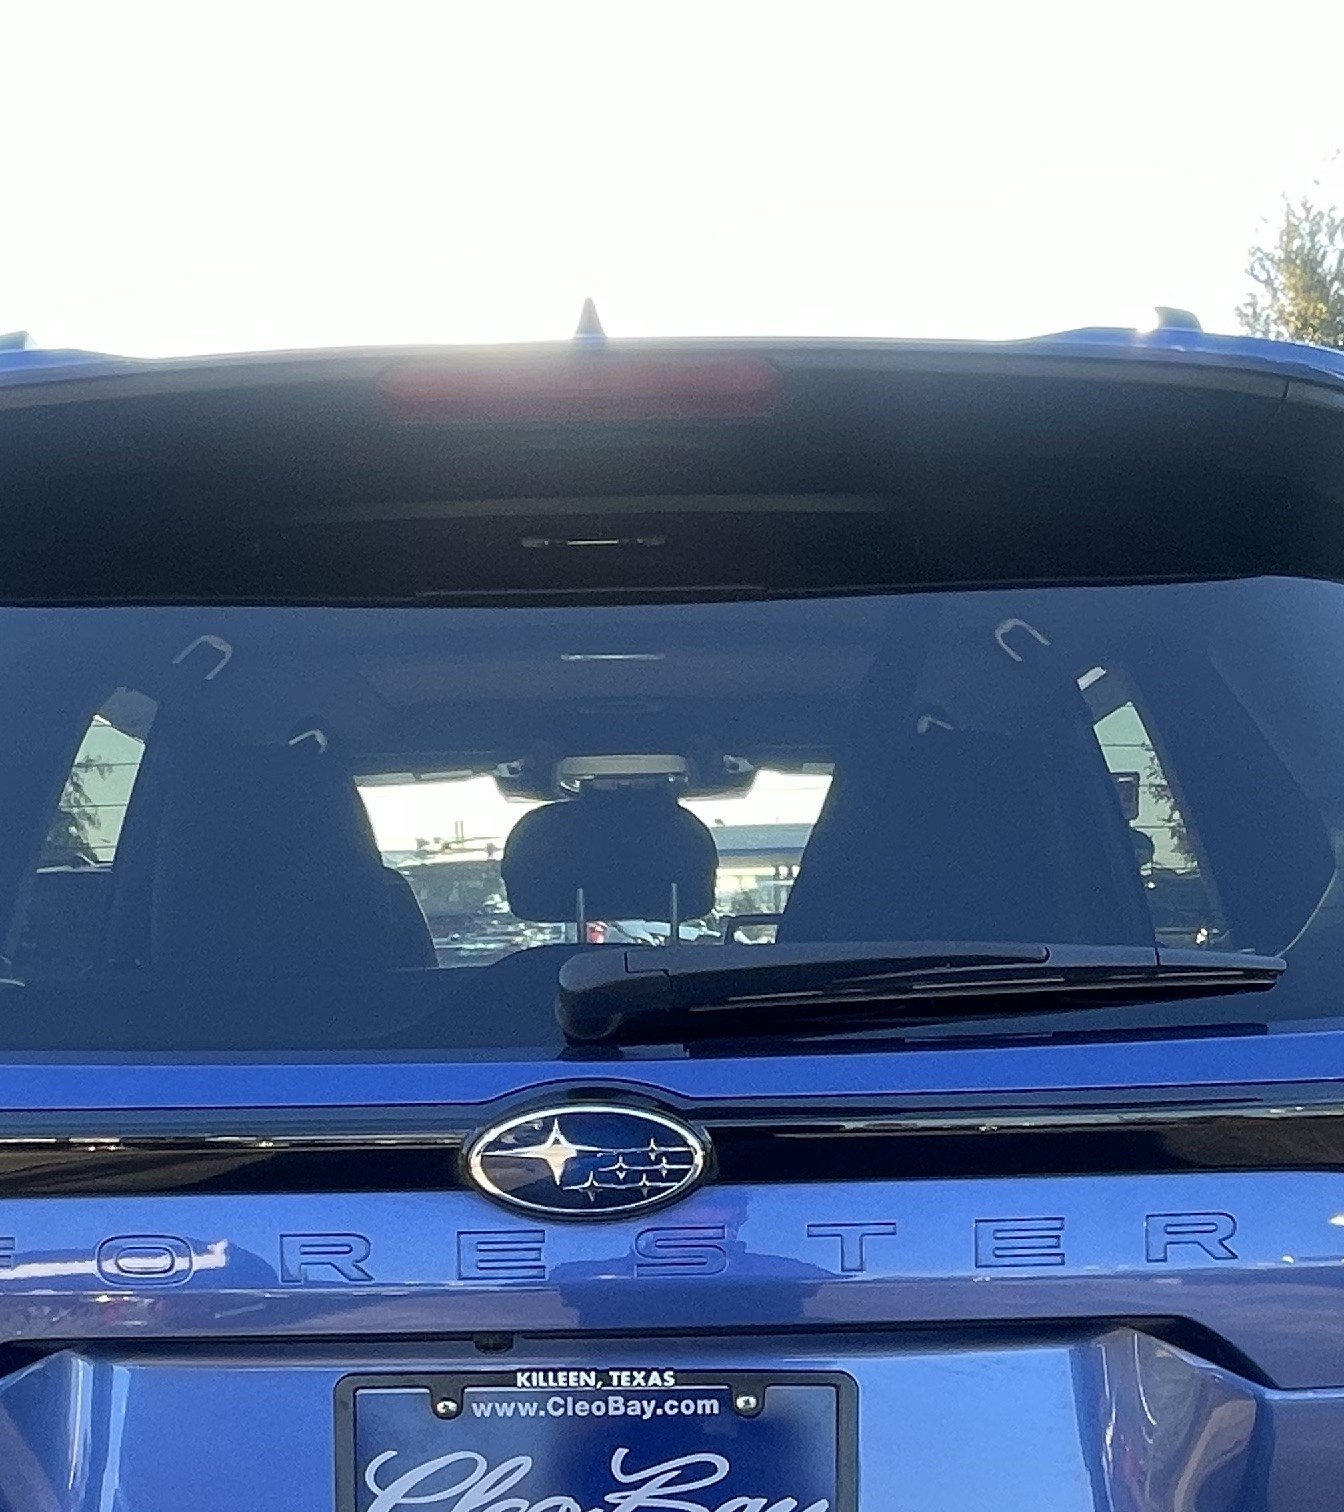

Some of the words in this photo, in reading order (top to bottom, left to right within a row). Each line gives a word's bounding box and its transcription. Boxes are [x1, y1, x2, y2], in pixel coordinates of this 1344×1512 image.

[516, 1371, 604, 1389] KILLEEN,
[609, 1370, 676, 1388] TEXAS
[471, 1396, 720, 1420] www.CleoBay.com
